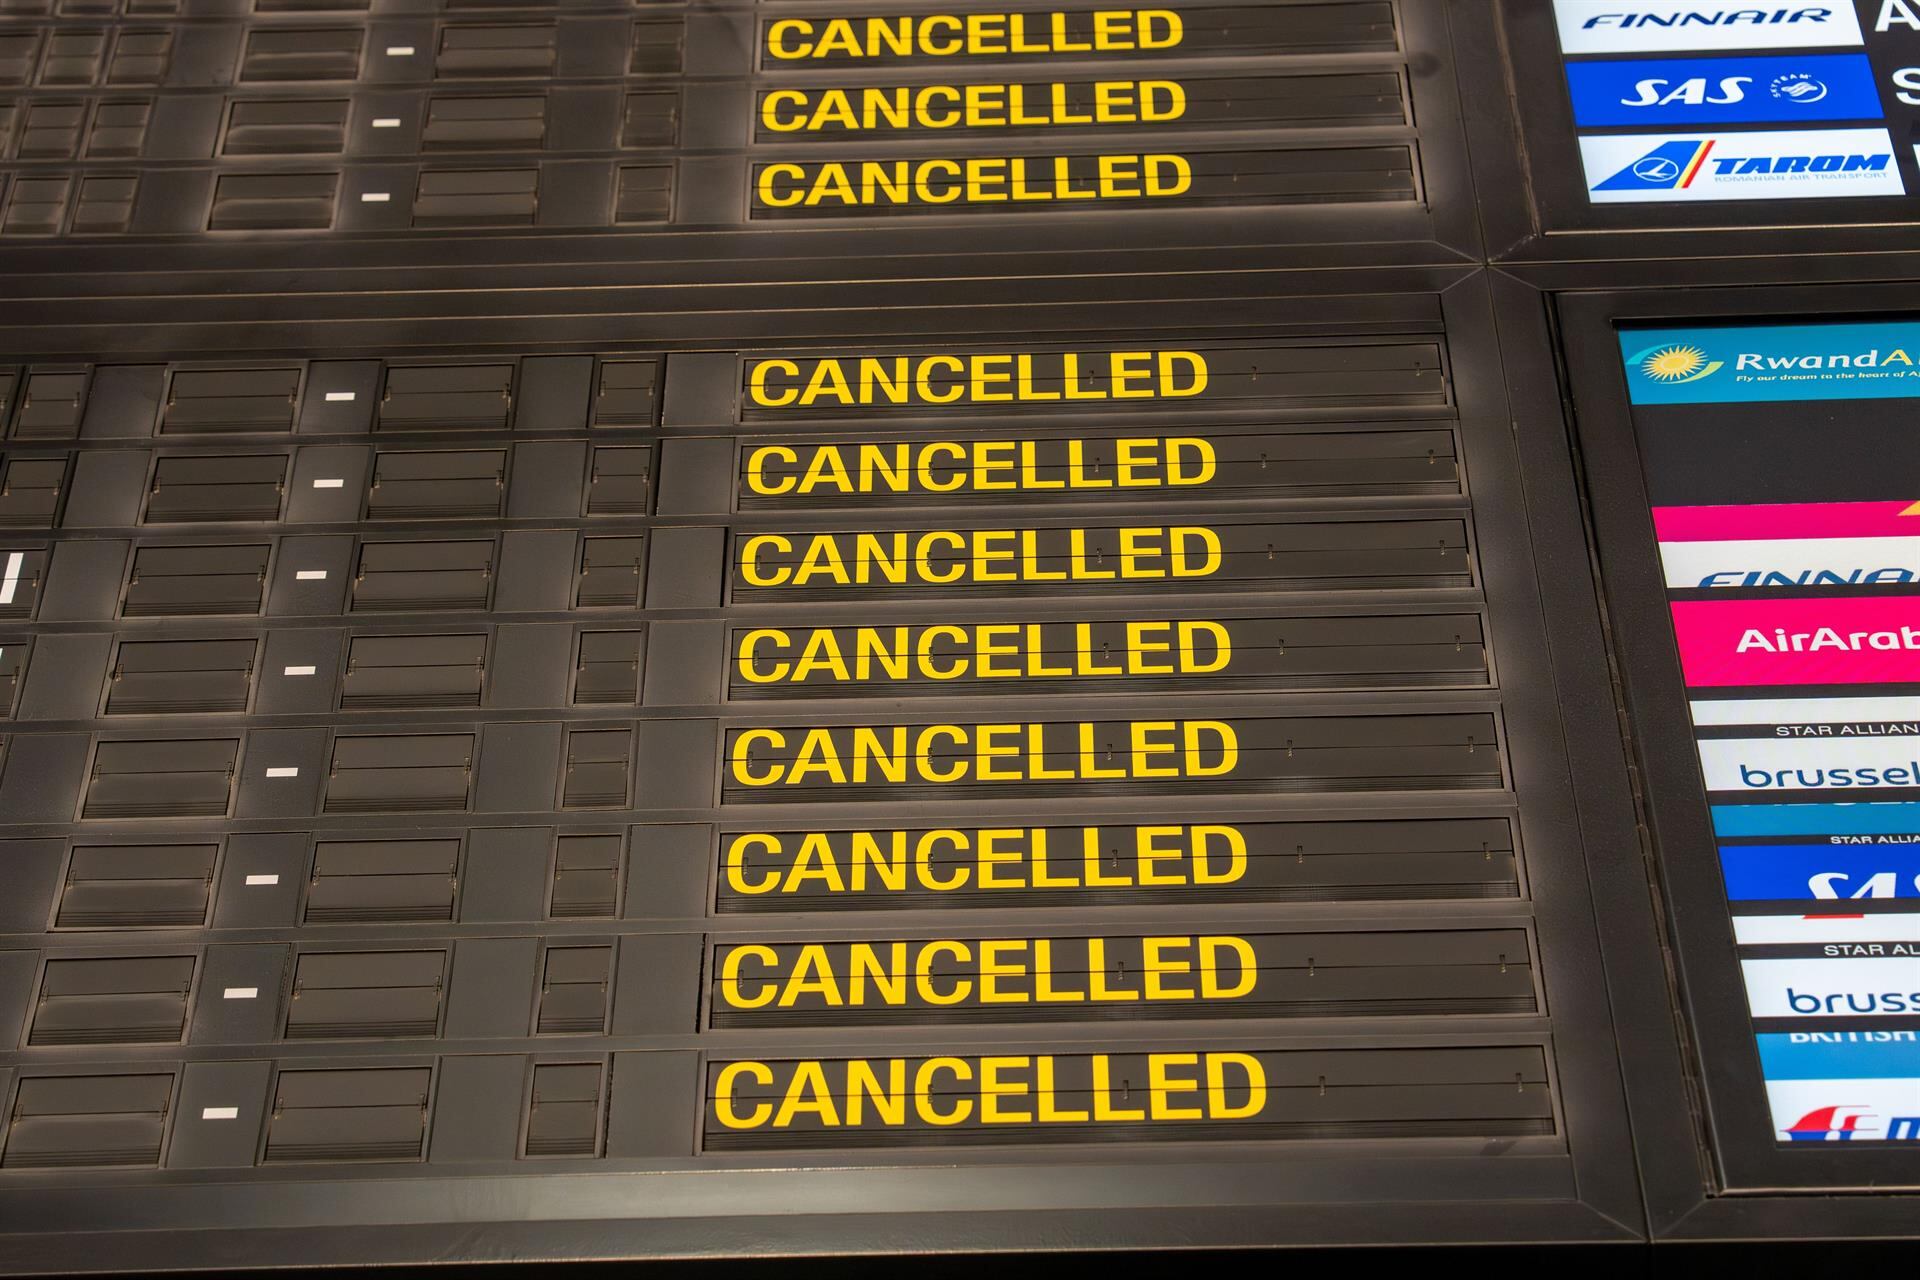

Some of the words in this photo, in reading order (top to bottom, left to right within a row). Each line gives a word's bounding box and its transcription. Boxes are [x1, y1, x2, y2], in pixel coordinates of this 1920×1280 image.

[1582, 7, 1832, 29] FINNAIR
[1875, 0, 1920, 32] A
[768, 10, 1183, 59] CANCELLED
[762, 81, 1185, 131] CANCELLED
[1621, 76, 1753, 107] SAS
[759, 155, 1191, 206] CANCELLED
[1713, 154, 1890, 175] TAROM
[1714, 174, 1785, 183] ROMANIAN
[1790, 173, 1810, 181] AIR
[1815, 171, 1888, 180] TRANSPORT
[1736, 349, 1920, 370] RwandA
[751, 352, 1207, 406] CANCELLED
[1736, 375, 1754, 383] Fly
[1893, 370, 1906, 378] of
[748, 438, 1216, 494] CANCELLED
[742, 527, 1221, 586] CANCELLED
[1697, 568, 1920, 588] FINNA
[739, 621, 1231, 683] CANCELLED
[1776, 725, 1833, 737] STAR
[733, 721, 1238, 786] CANCELLED
[1830, 835, 1872, 844] STAR
[727, 826, 1247, 894] CANCELLED
[1808, 872, 1920, 899] SA
[1823, 944, 1884, 956] STAR
[722, 937, 1257, 1008] CANCELLED
[715, 1053, 1266, 1129] CANCELLED
